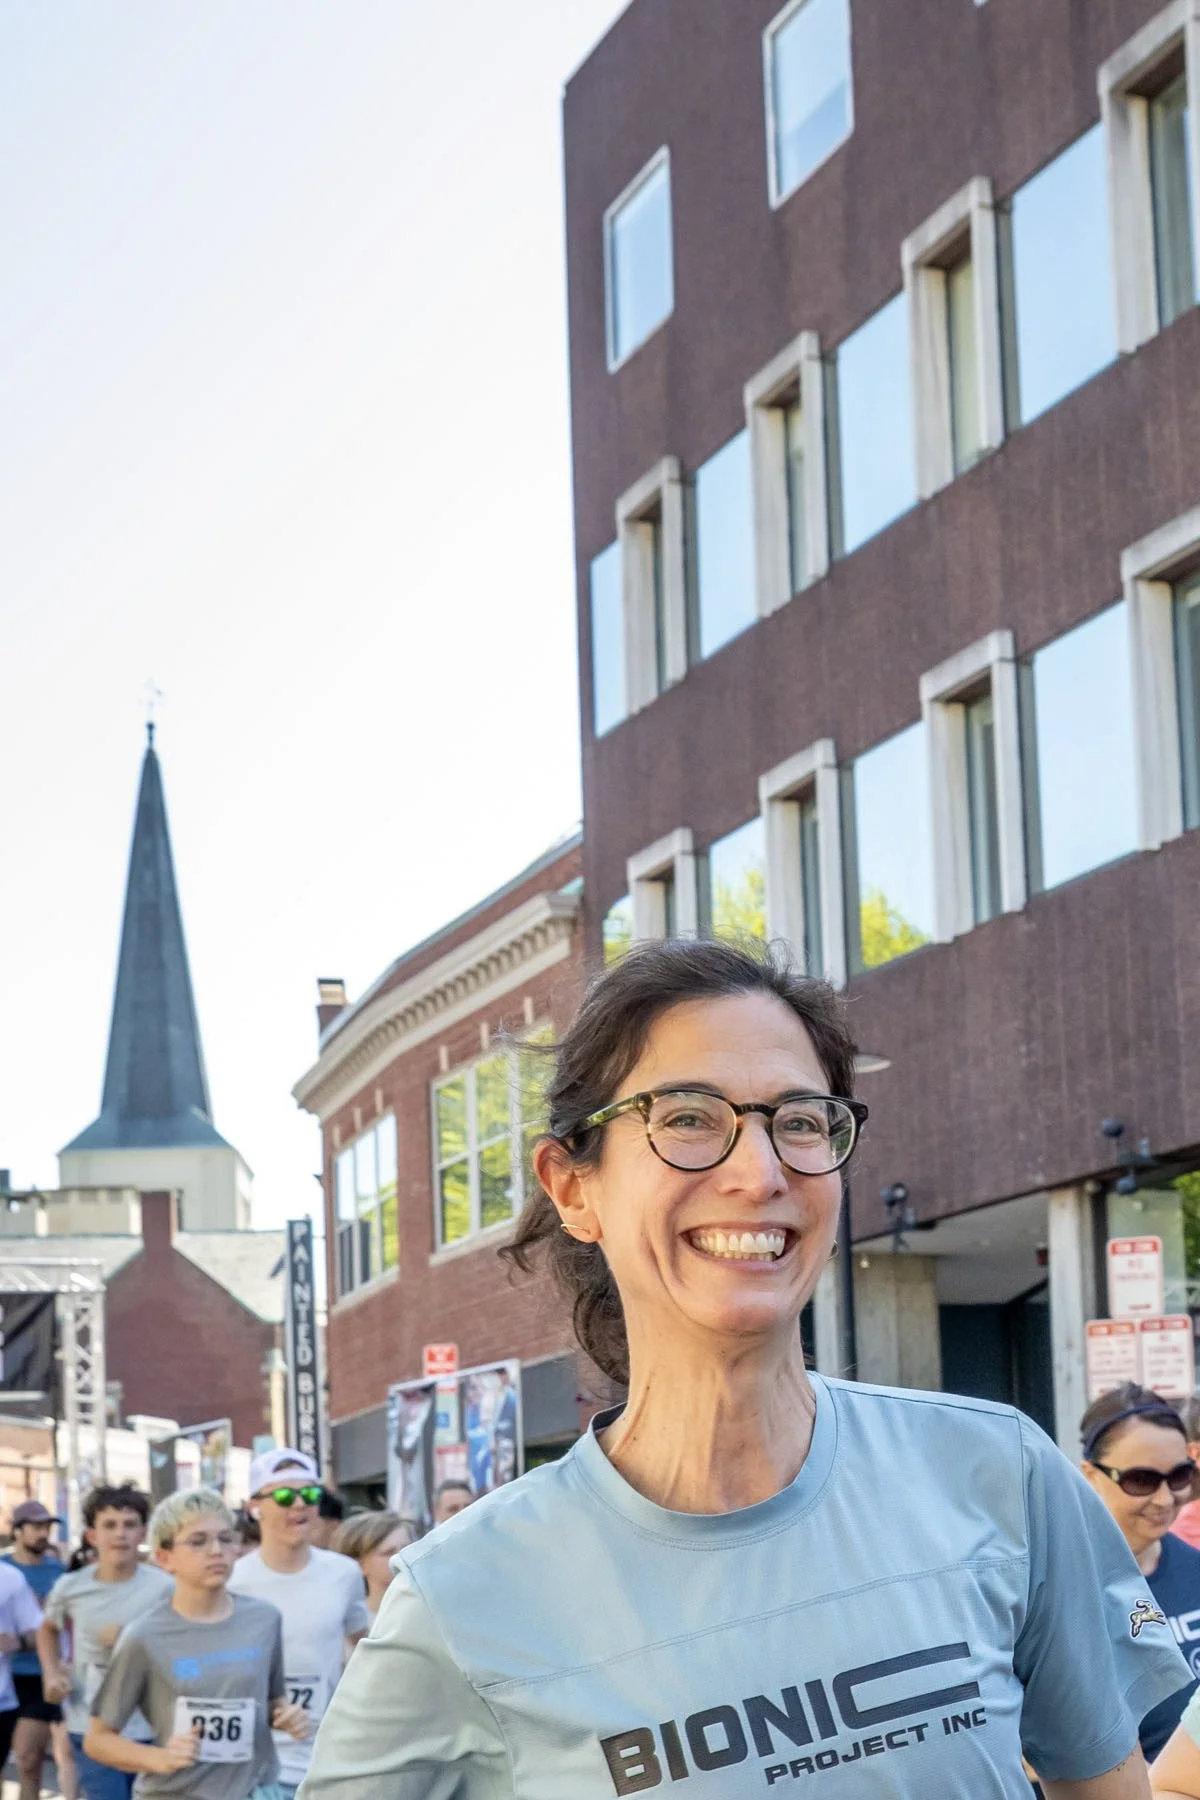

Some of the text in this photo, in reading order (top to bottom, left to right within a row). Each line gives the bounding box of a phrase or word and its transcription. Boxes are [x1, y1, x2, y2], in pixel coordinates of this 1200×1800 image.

[293, 1221, 316, 1459] PAINTED BURR
[289, 1688, 313, 1709] 72
[600, 1641, 980, 1797] BIONIC
[764, 1707, 987, 1785] PROJECT INC
